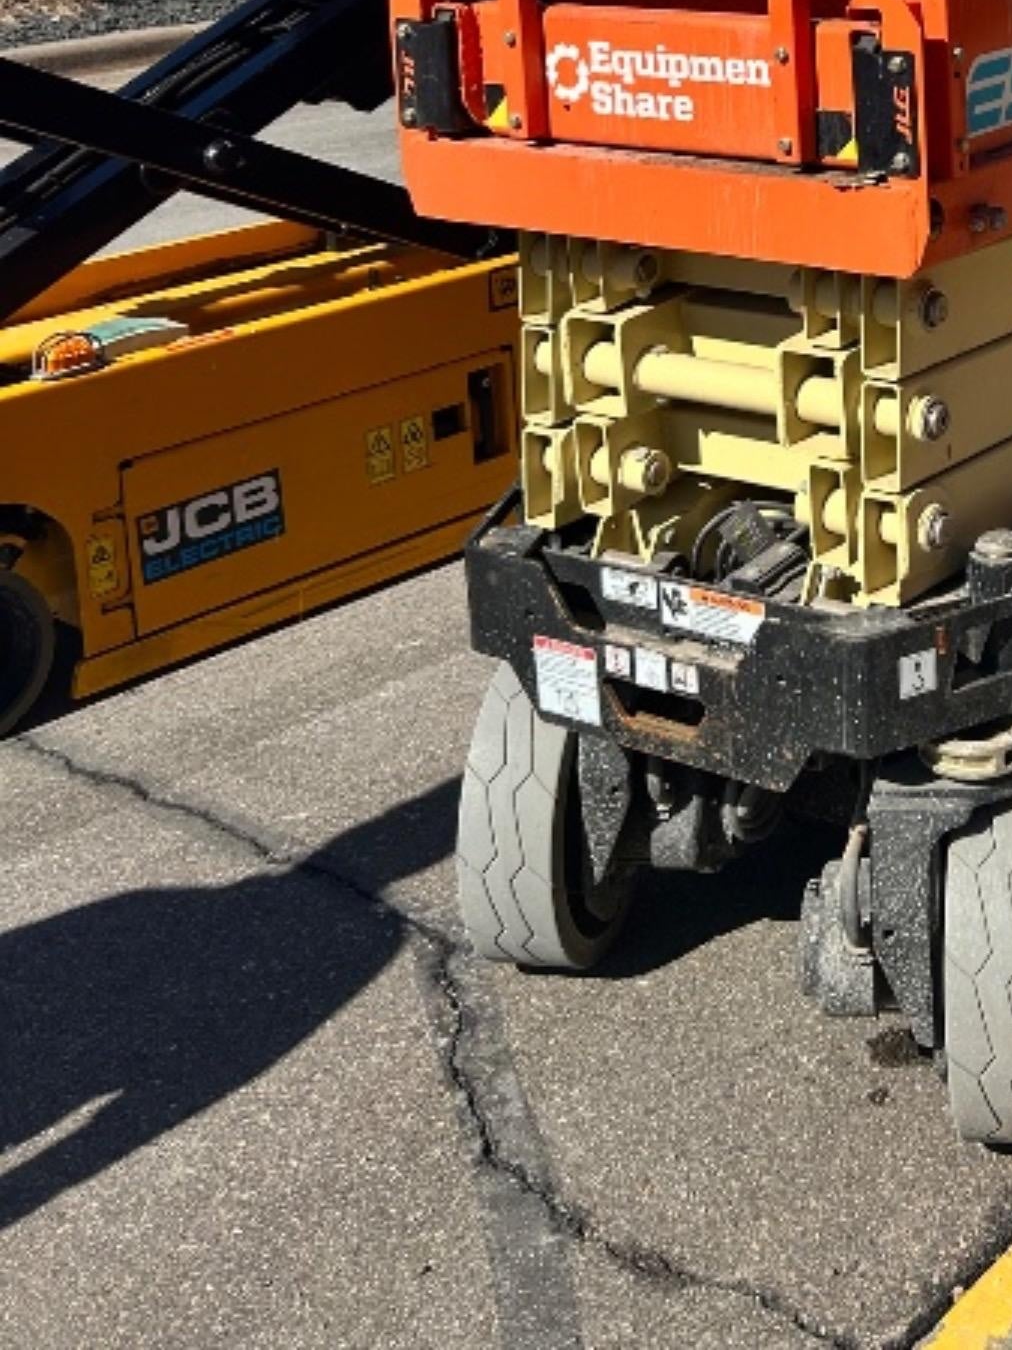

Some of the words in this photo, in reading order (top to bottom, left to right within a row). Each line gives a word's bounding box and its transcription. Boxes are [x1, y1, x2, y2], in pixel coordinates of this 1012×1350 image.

[590, 80, 695, 122] Share
[142, 476, 279, 555] JCB
[145, 515, 284, 581] ELECTRIC
